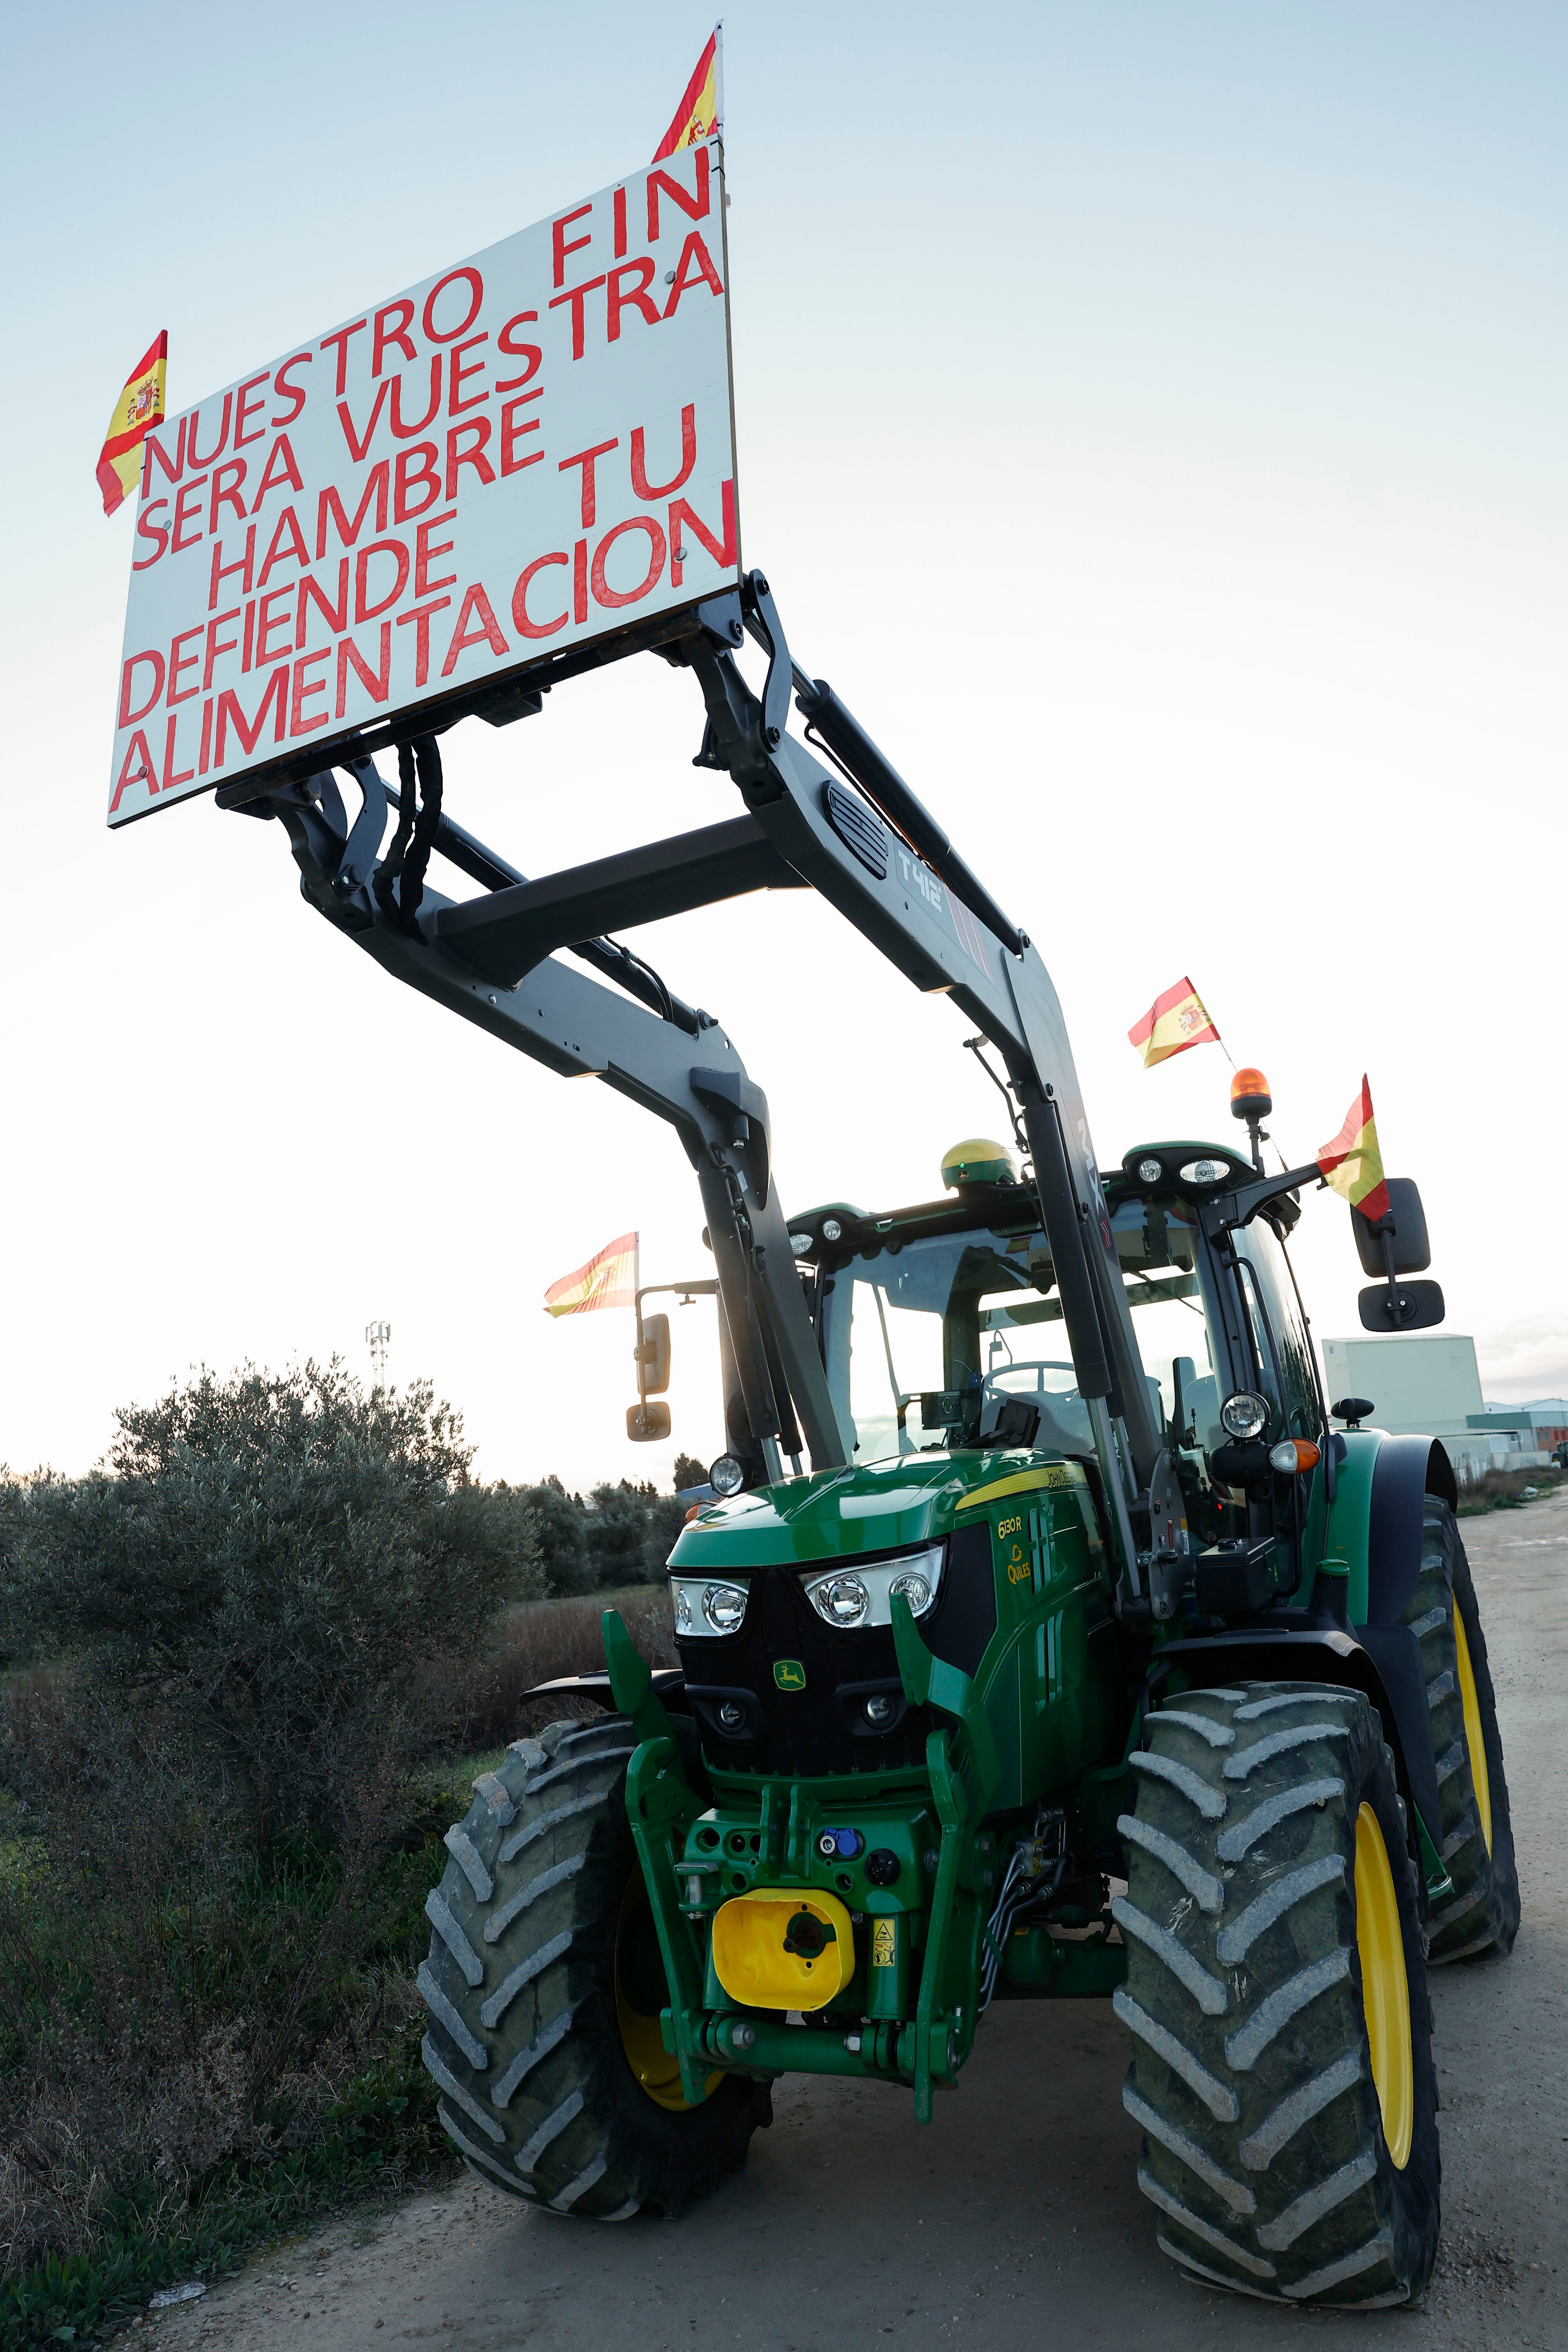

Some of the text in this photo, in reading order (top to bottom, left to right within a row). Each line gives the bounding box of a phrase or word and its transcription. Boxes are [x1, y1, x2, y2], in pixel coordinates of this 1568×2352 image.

[133, 231, 724, 570] SERA VUESTRA
[142, 146, 710, 499] NUESTRO FIN
[110, 479, 737, 812] ALIMENTACION
[119, 403, 696, 729] DEFIENDE TU
[208, 387, 544, 610] HAMBRE
[1008, 1562, 1030, 1585] QUILES
